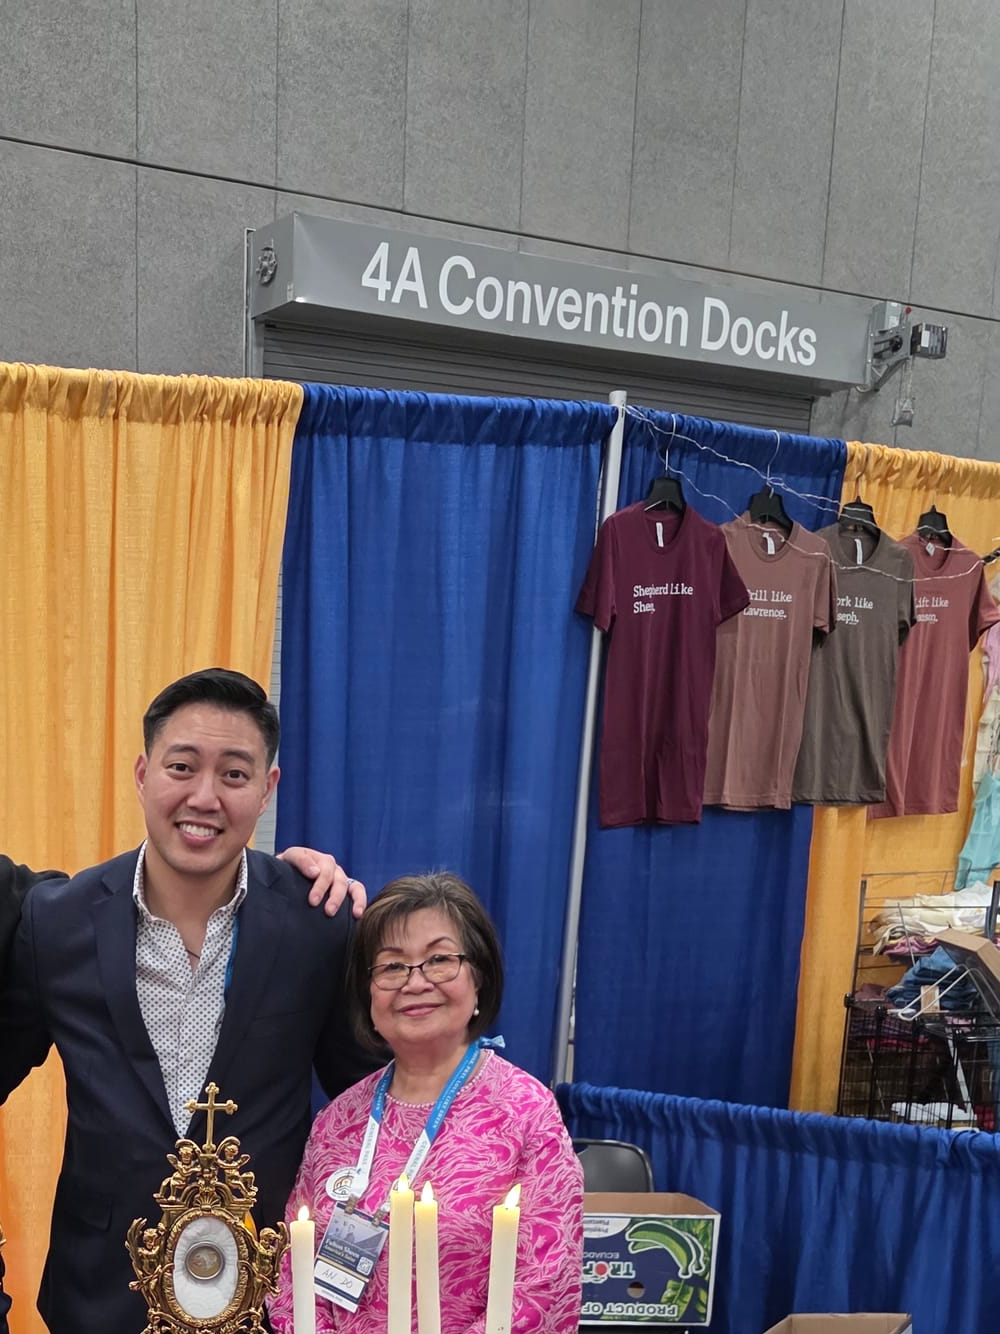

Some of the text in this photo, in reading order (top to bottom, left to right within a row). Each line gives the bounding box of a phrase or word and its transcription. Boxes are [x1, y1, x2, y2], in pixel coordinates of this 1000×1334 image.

[361, 241, 817, 367] 4A Convention Docks
[747, 589, 792, 602] rill like
[836, 595, 873, 609] ork like
[836, 611, 859, 625] seph.
[583, 1251, 620, 1260] ECUADO
[581, 1302, 678, 1316] PRODUCT OF
